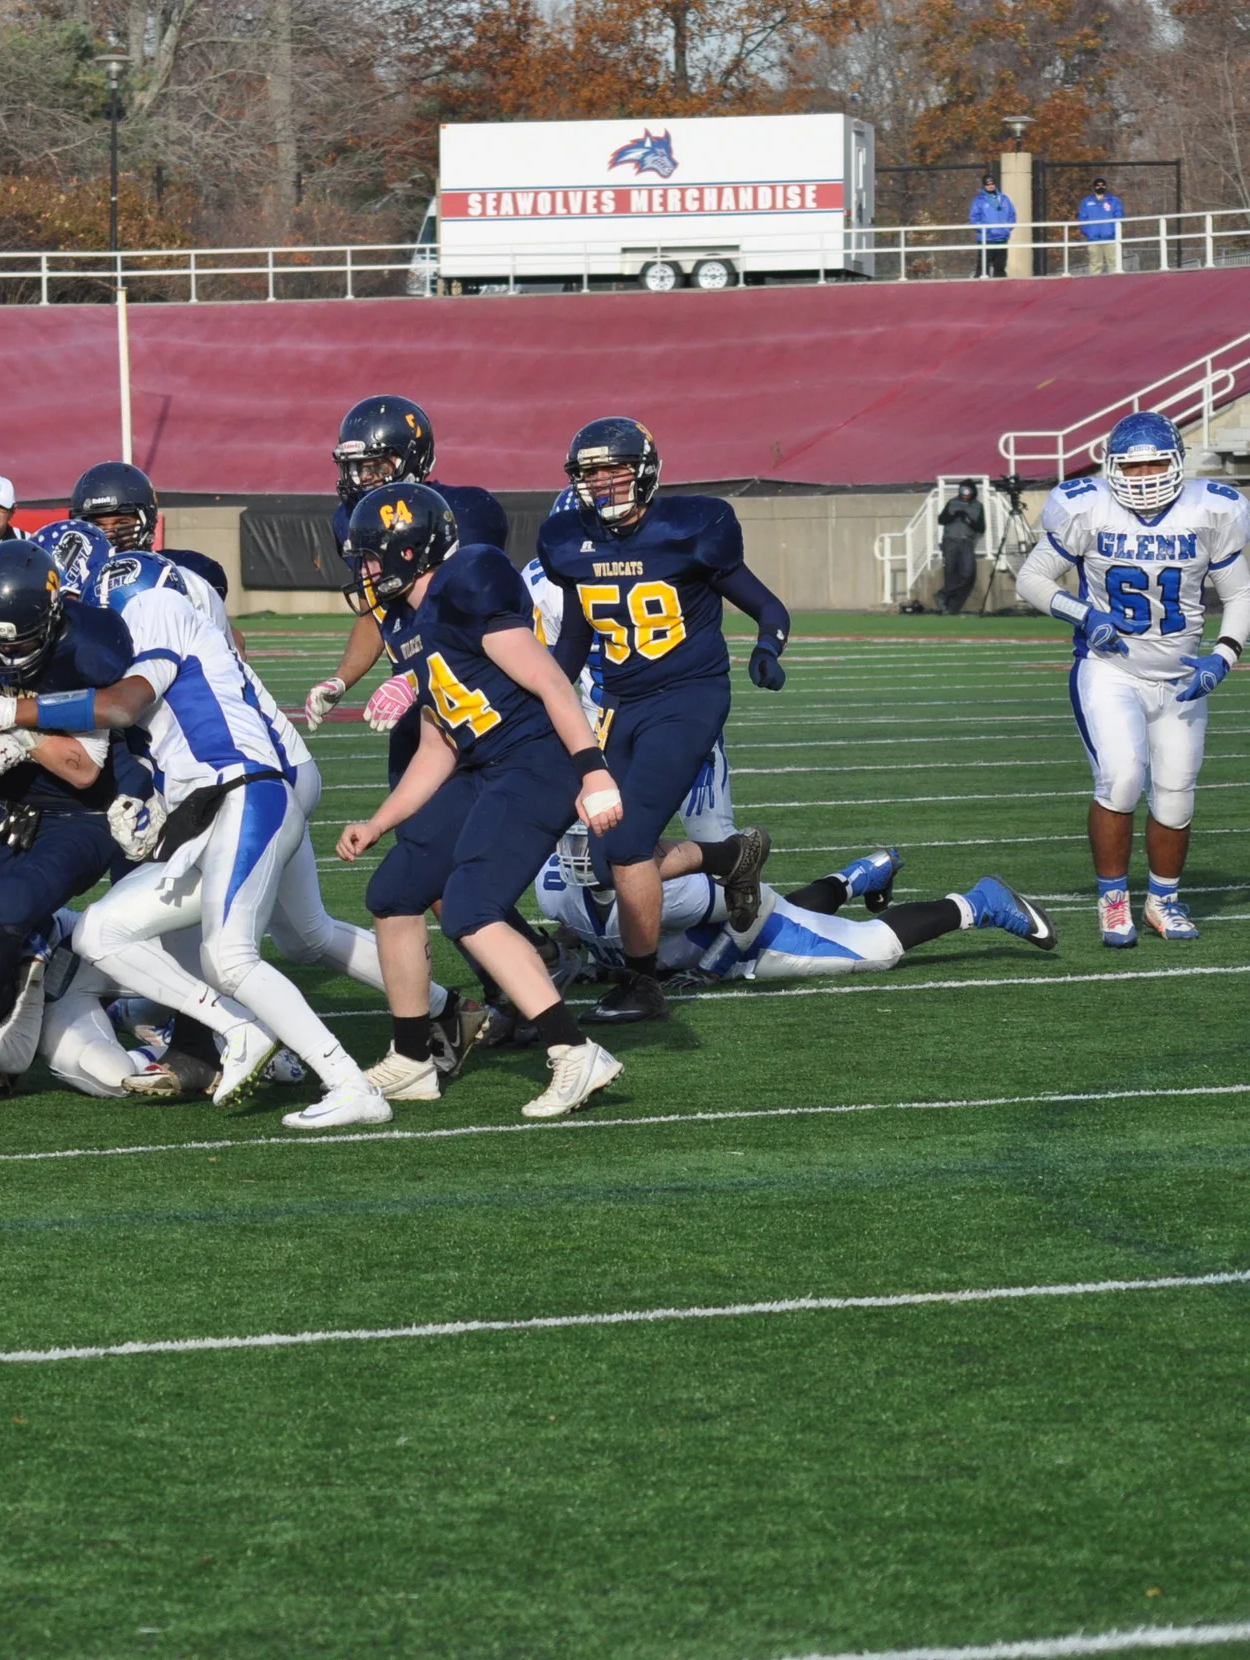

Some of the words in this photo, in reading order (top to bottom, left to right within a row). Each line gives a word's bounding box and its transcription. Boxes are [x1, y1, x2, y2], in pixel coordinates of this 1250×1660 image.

[467, 190, 616, 217] SEAWOLVES
[630, 185, 817, 214] MERCHANDISE
[379, 500, 413, 529] 64
[1097, 531, 1198, 561] GLENN
[592, 561, 644, 577] WILDCATS
[1105, 565, 1187, 636] 61
[576, 580, 687, 665] 58
